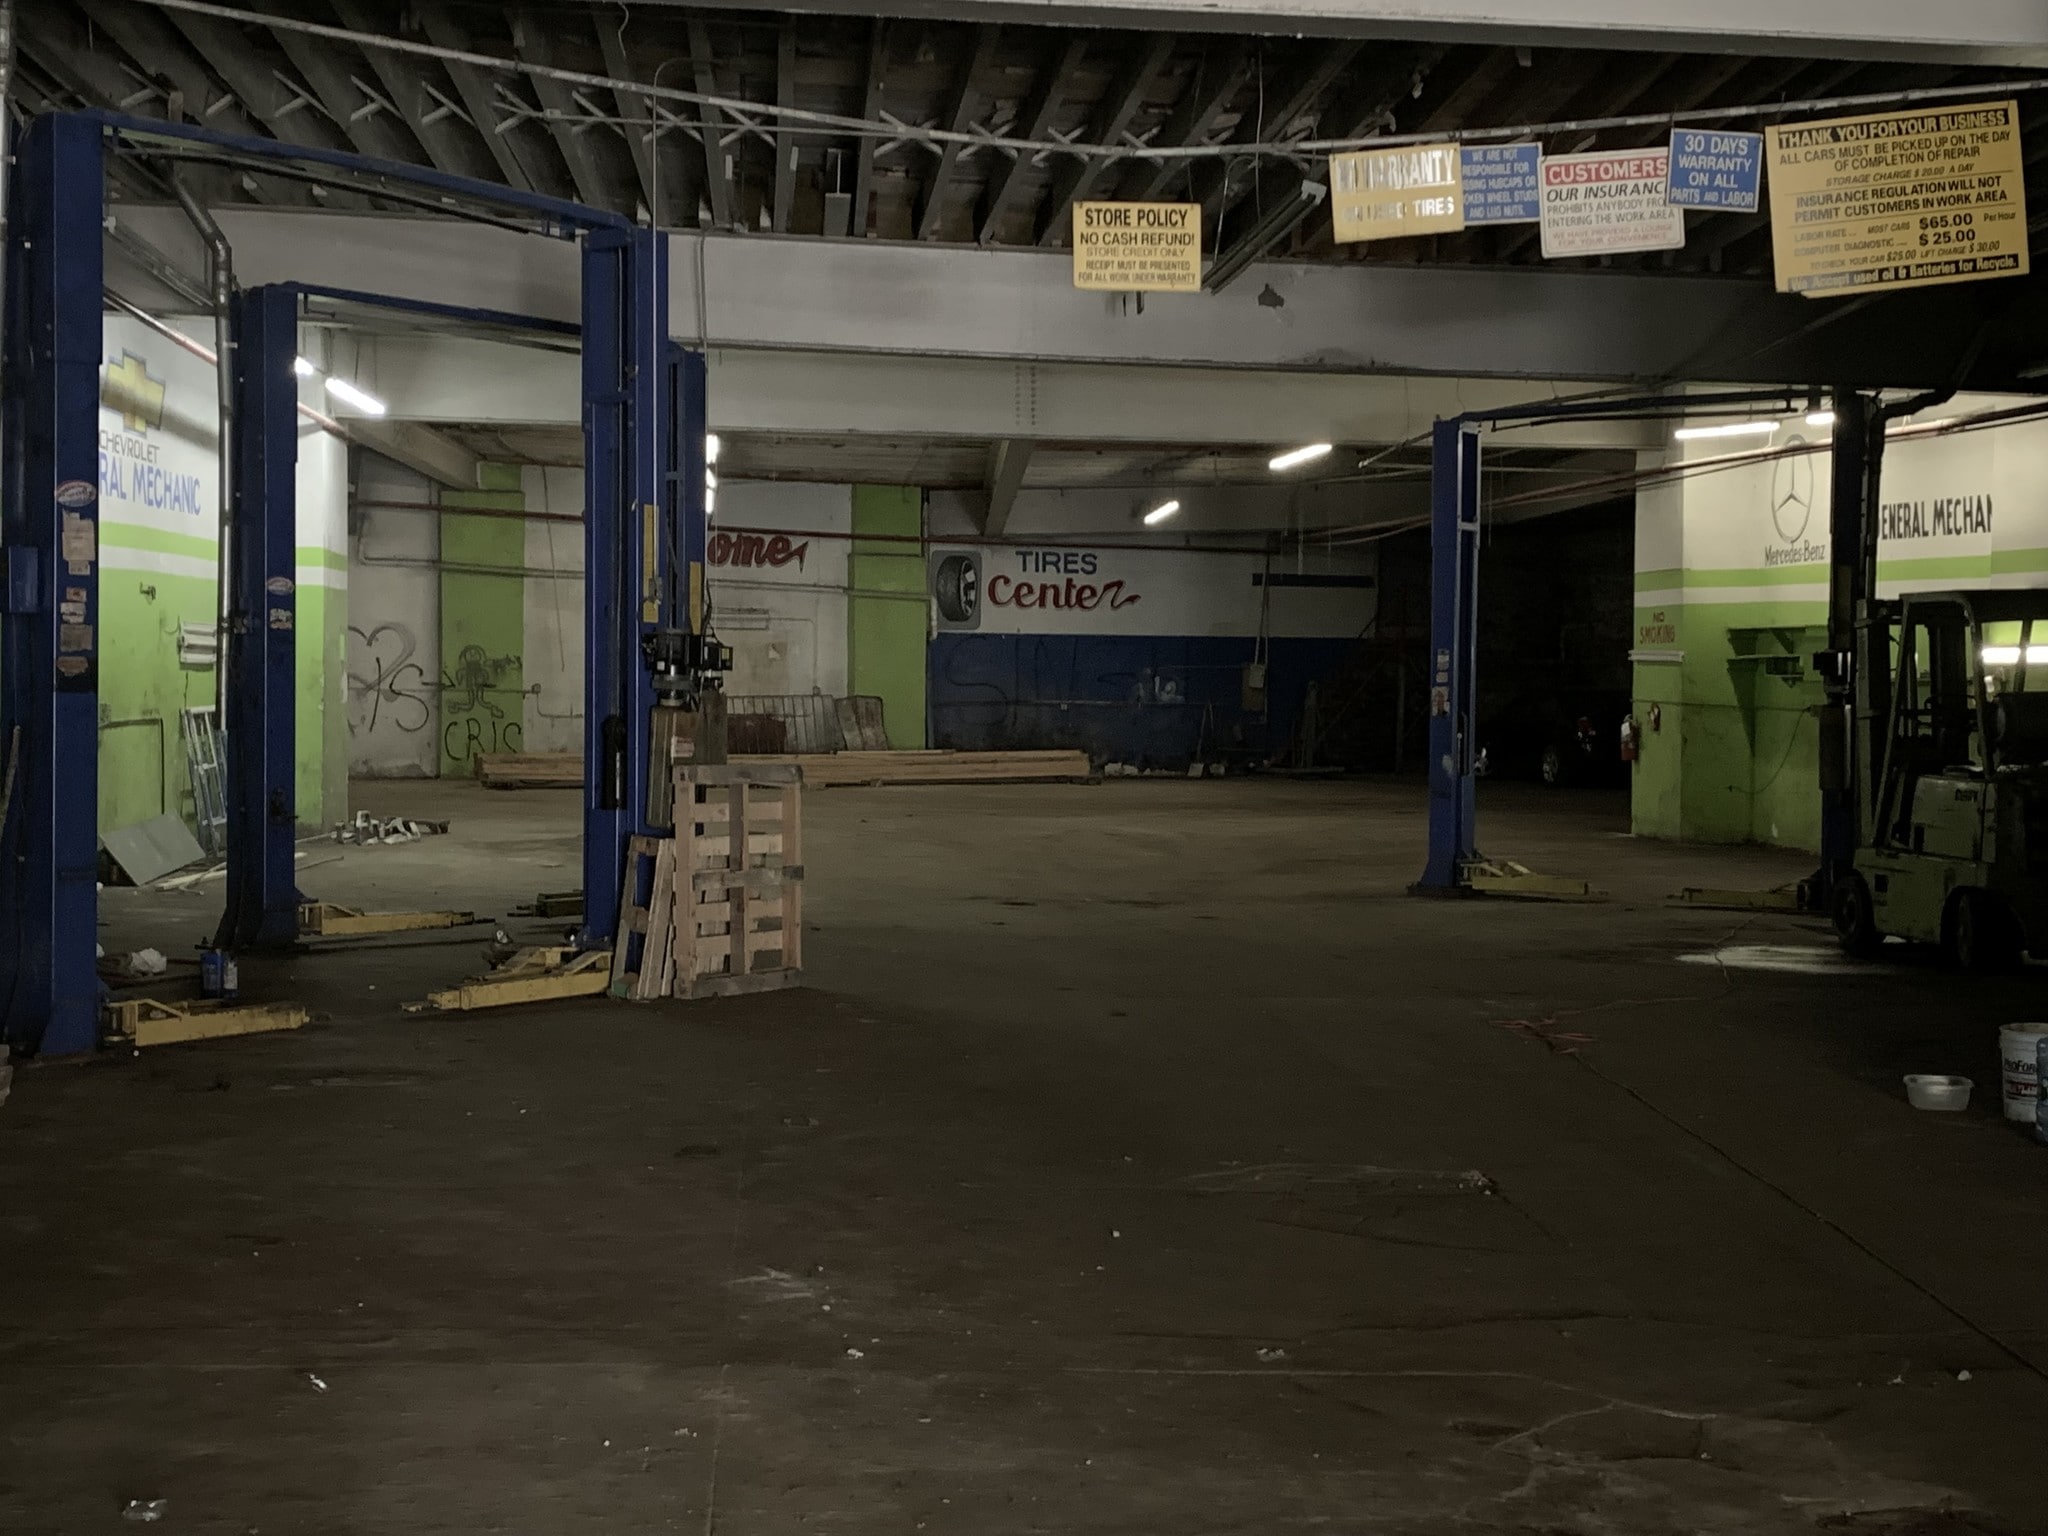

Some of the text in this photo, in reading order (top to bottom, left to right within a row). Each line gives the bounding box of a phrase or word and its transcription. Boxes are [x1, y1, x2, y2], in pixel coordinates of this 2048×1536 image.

[1779, 110, 2006, 149] THANK YOU FOR YOUR BUSINESS
[1685, 134, 1749, 155] 30 DAYS
[1780, 129, 2011, 166] ALL CARS MUST BE PICKED UP ON THE DAY
[1362, 149, 1455, 191] RRANTY
[1514, 161, 1530, 174] FOR
[1549, 157, 1667, 184] CUSTOMERS
[1679, 154, 1752, 173] WARRANTY
[1834, 146, 1980, 172] OF COMPLETION OF REPAIR
[1688, 171, 1738, 188] ON ALL
[1826, 173, 1871, 187] STORAGE
[1872, 169, 1912, 182] CHARGE
[1949, 165, 1956, 174] A
[1958, 163, 1975, 172] DAY
[1547, 180, 1667, 203] OUR INSURANC
[1671, 187, 1754, 206] PARTS AND LABOR
[1796, 175, 2002, 208] INSURANCE REGULATION WILL NOT
[1085, 208, 1188, 227] STORE POLICY
[1412, 196, 1455, 217] TIRES
[1547, 197, 1666, 215] PROHIBITS ANYBODY FRO
[1795, 189, 2008, 223] PERMIT CUSTOMERS IN WORK AREA
[1547, 208, 1676, 229] ENTERING THE WORK AREA
[1825, 228, 1847, 240] RATE
[1919, 213, 1973, 231] $65.00
[1984, 213, 1997, 222] Per
[1998, 210, 2017, 220] Hour
[1080, 232, 1195, 246] NO CASH REFUND!
[1844, 238, 1894, 252] DIAGNOSTIC
[1919, 231, 1928, 246] $
[1933, 229, 1976, 245] 25.00
[1086, 247, 1186, 258] STORE CREDIT ONLY
[1886, 249, 1917, 263] $25.00
[1969, 244, 1975, 254] $
[1086, 260, 1191, 271] RECEIPT MUST BE PRESENTED
[1853, 269, 1879, 284] used
[1882, 266, 1895, 281] oil
[1909, 261, 1956, 279] Batteries
[1959, 258, 1974, 273] for
[1079, 272, 1093, 283] FOR
[1095, 272, 1107, 282] ALL
[1109, 272, 1130, 282] WORK
[1156, 272, 1196, 284] WARRANTY
[99, 429, 160, 463] CHEVROLET
[132, 461, 201, 516] MECHANIC
[1881, 500, 1929, 540] ENERAL
[1015, 551, 1098, 575] TIRES
[1765, 540, 1826, 567] Mercedes-Benz
[987, 574, 1142, 611] Center
[1653, 611, 1665, 623] NO
[1639, 624, 1675, 645] SMOKING
